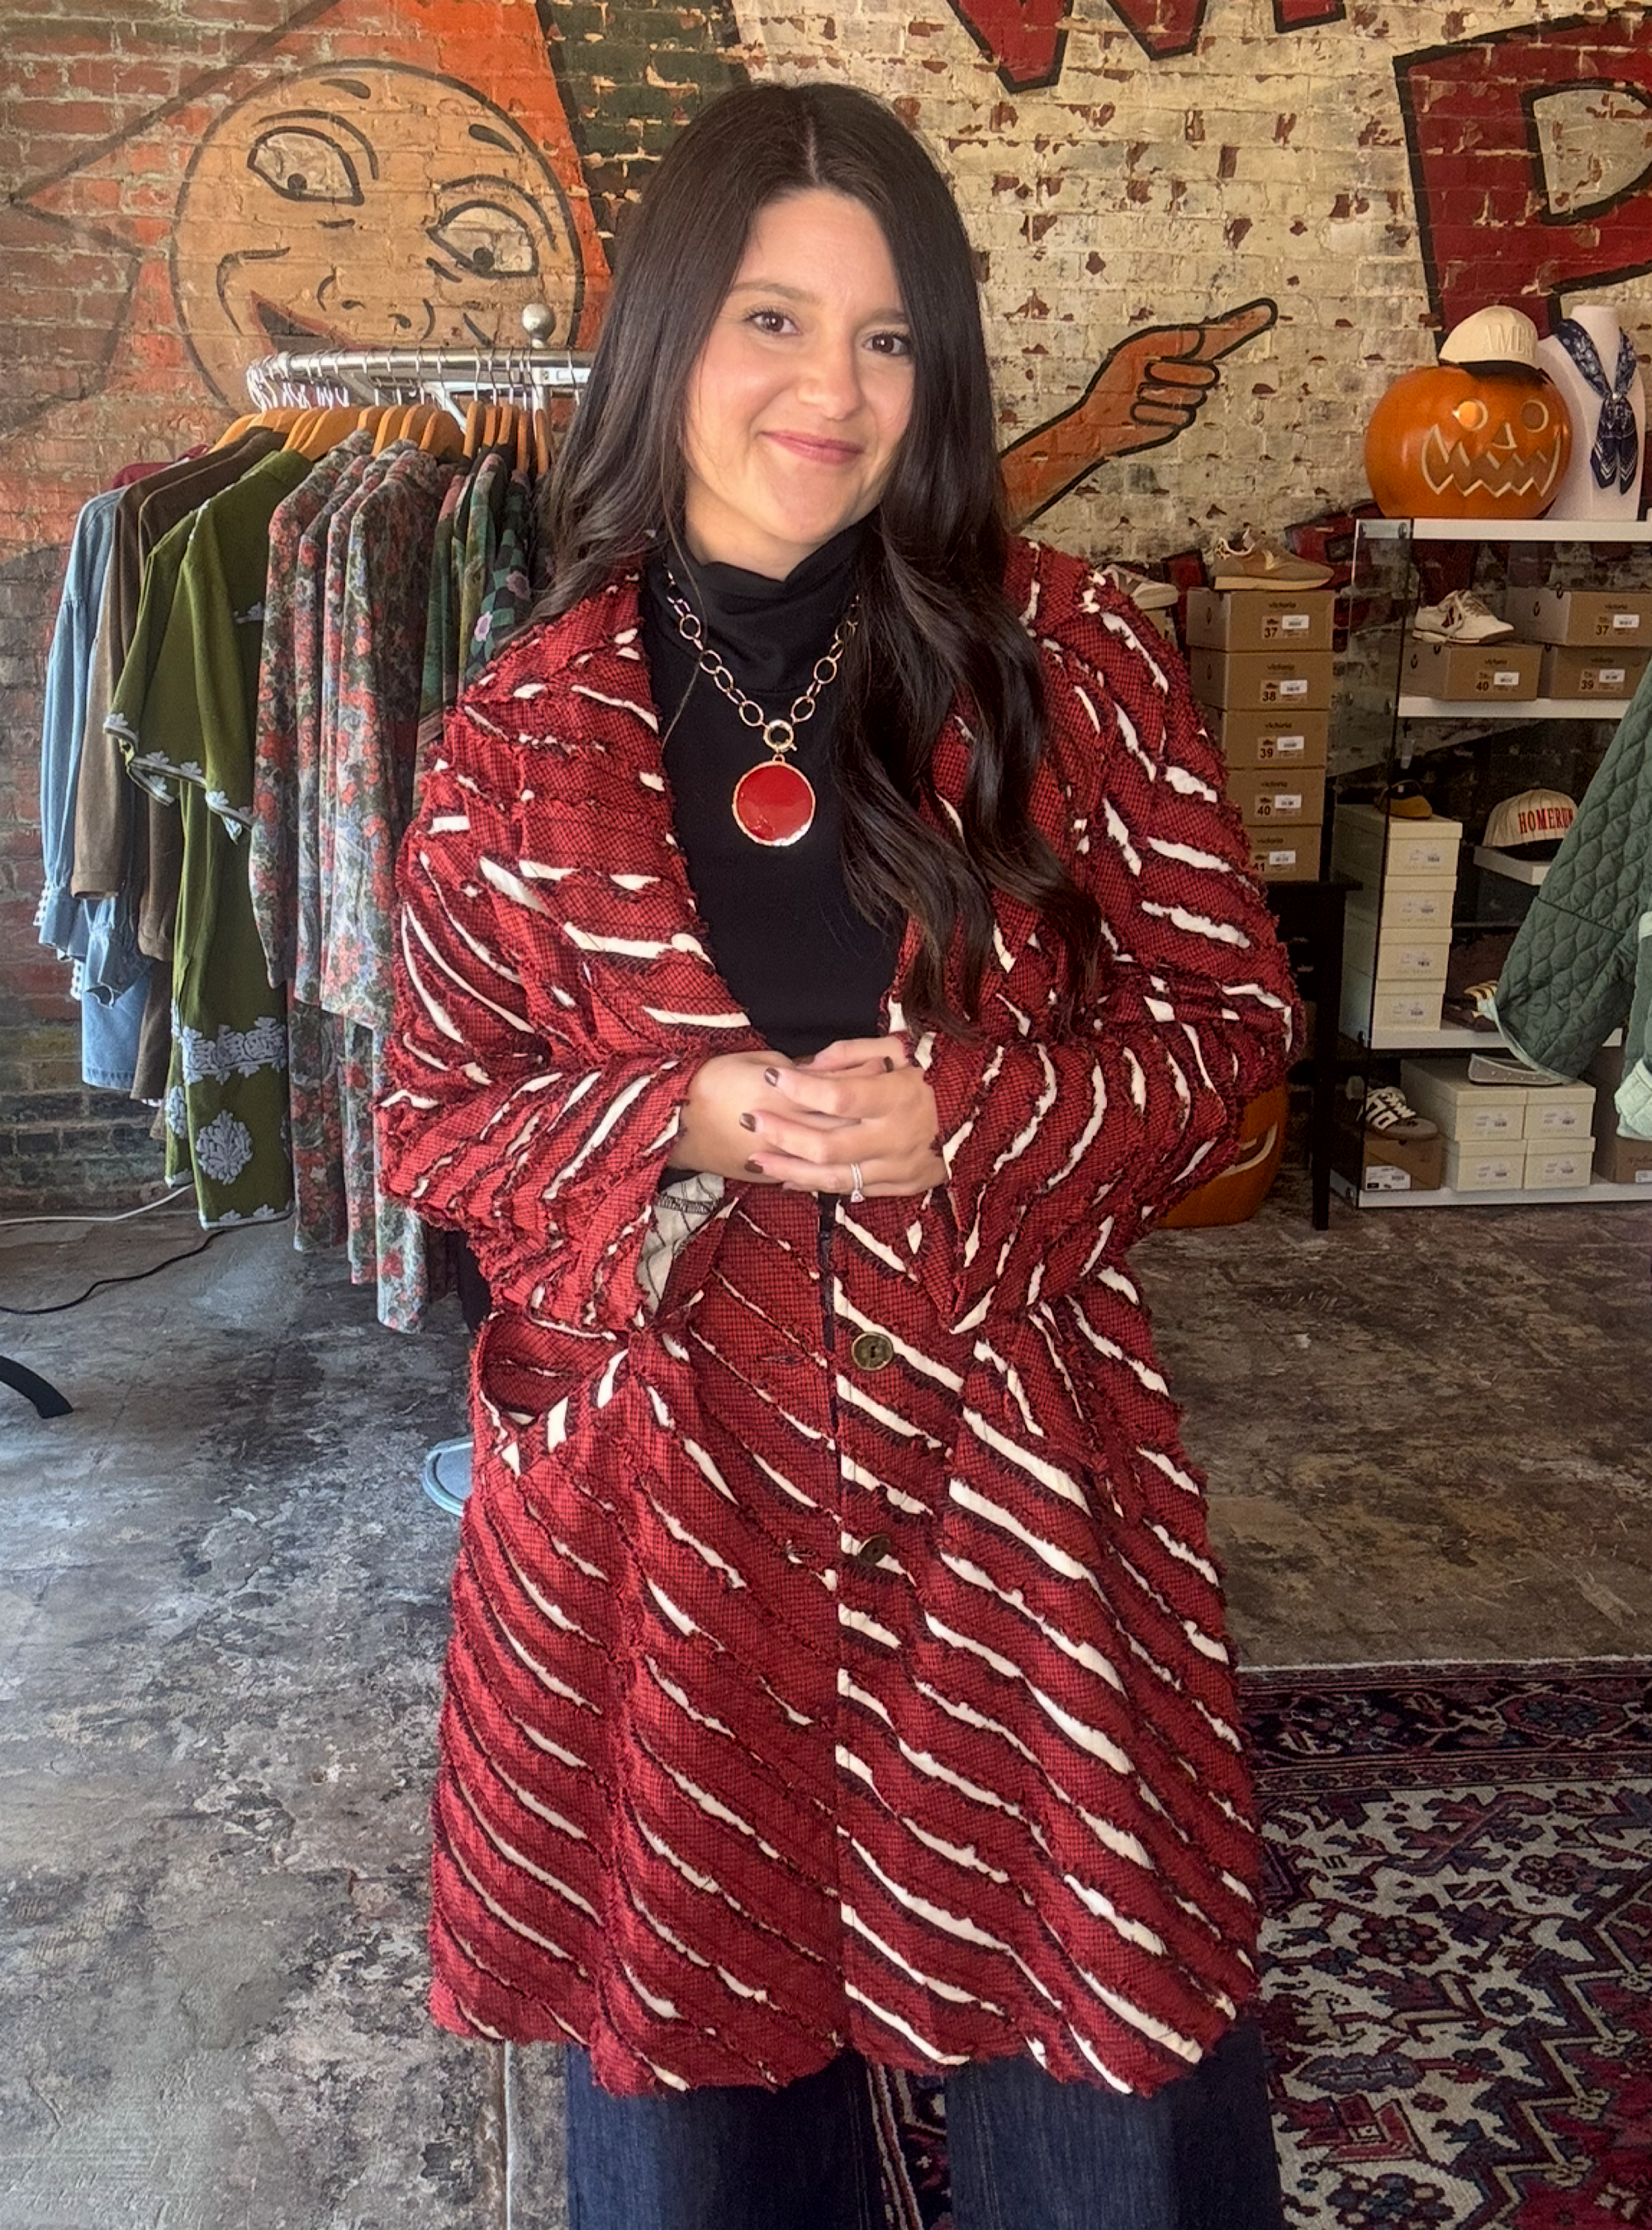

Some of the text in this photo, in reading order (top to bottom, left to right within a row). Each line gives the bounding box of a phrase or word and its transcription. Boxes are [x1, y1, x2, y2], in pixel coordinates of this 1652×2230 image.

[1264, 627, 1278, 638] 37
[1595, 624, 1610, 636] 37
[1476, 681, 1489, 691] 40
[1581, 679, 1594, 690] 39
[1262, 690, 1276, 702] 38
[1260, 747, 1274, 758] 39
[1257, 804, 1271, 816] 40
[1253, 861, 1265, 872] 41
